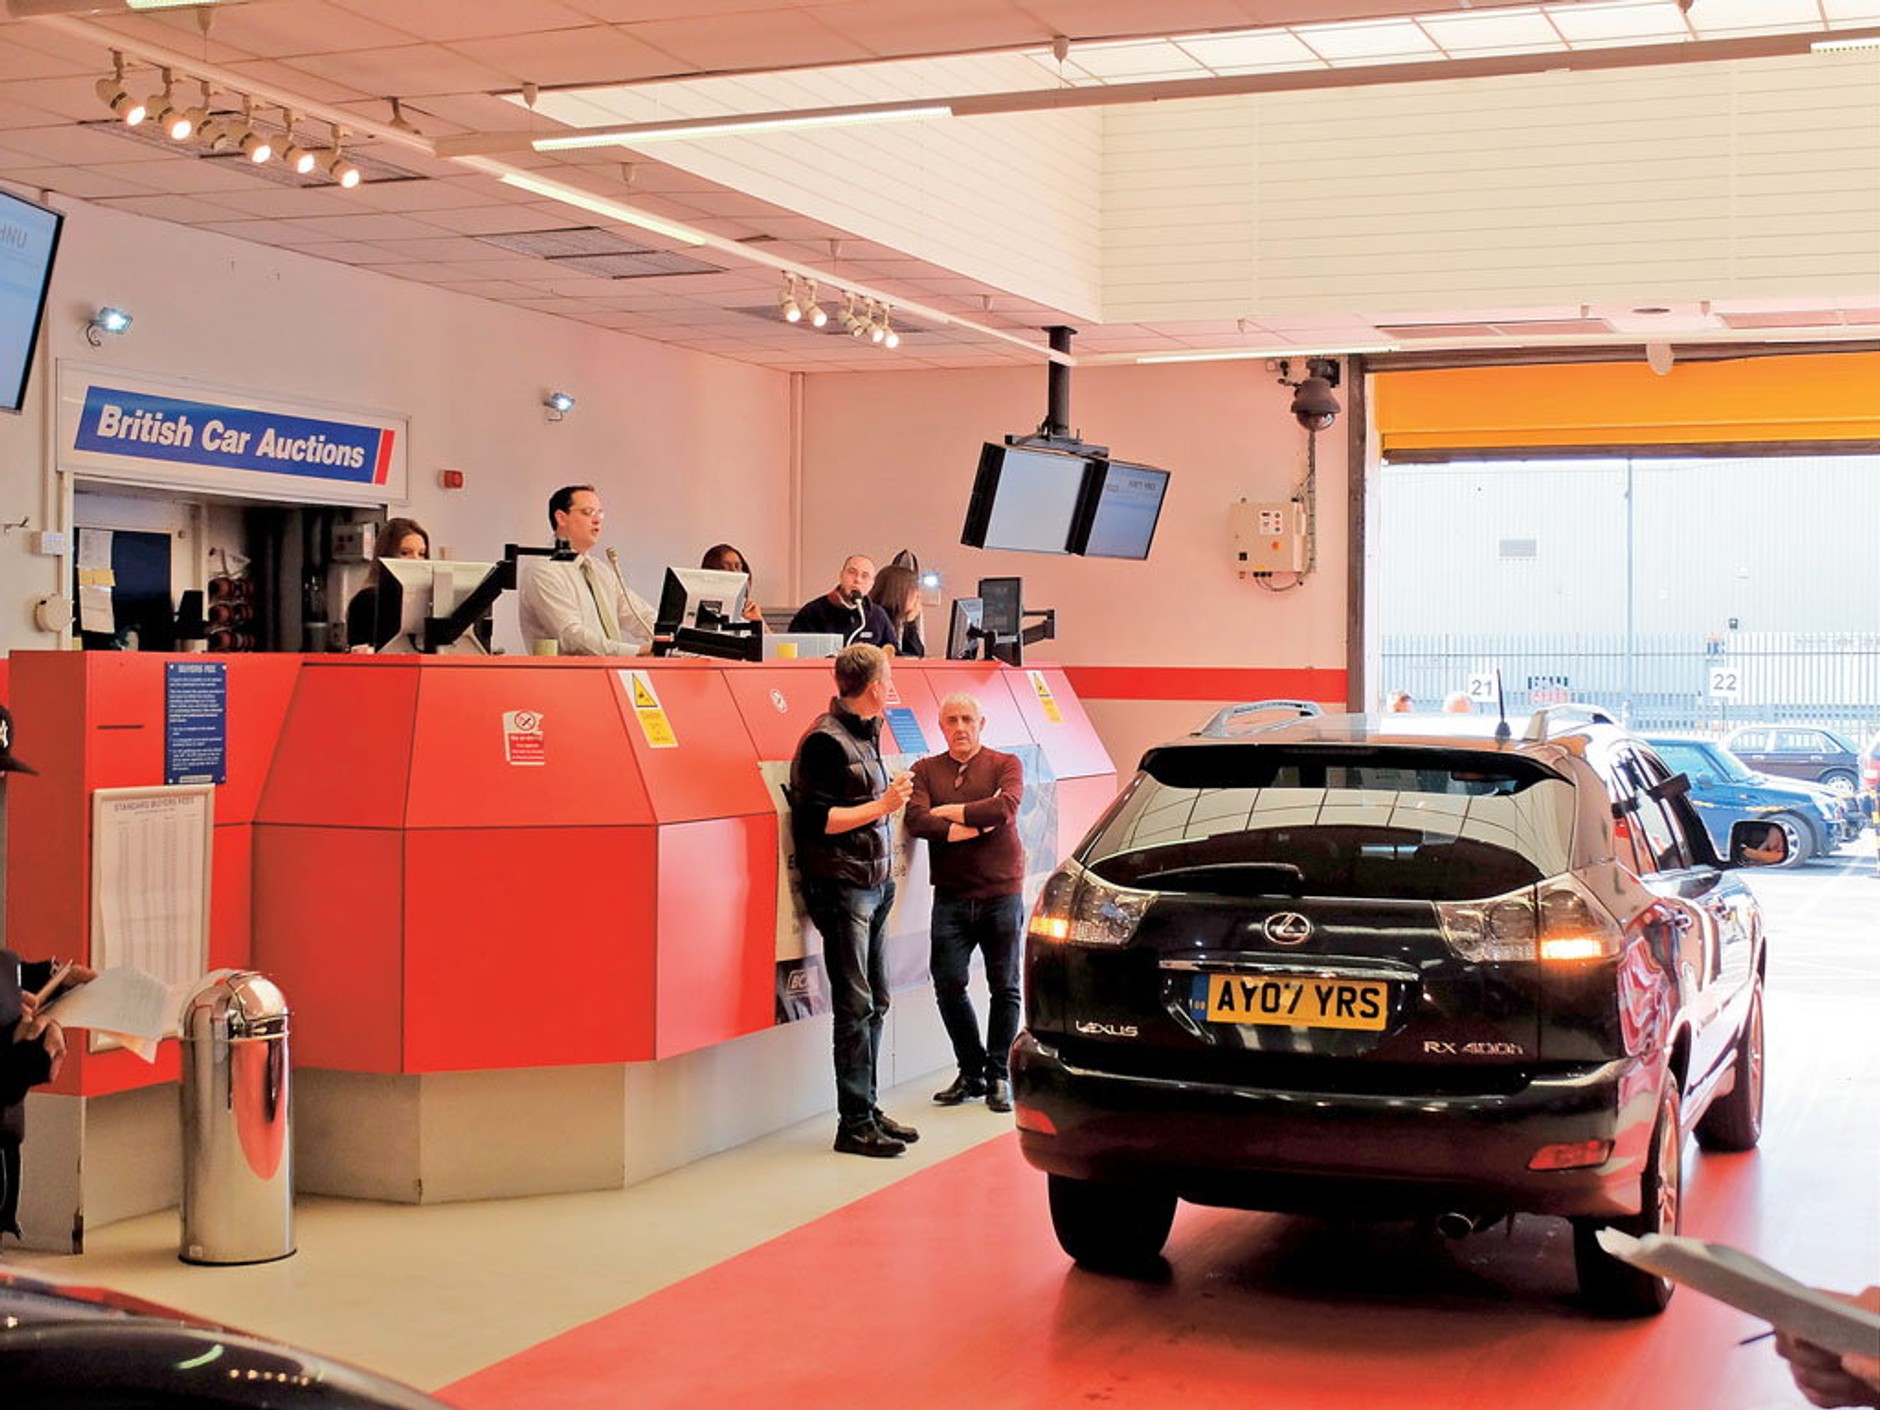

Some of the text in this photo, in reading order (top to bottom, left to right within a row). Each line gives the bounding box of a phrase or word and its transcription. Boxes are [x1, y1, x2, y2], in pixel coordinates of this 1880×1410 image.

[97, 404, 365, 468] British Car Auctions
[1471, 679, 1493, 696] 21
[1713, 673, 1737, 691] 22
[1217, 979, 1381, 1019] AY07 YRS
[1075, 1020, 1138, 1037] LEXUS
[1423, 1041, 1457, 1054] RX
